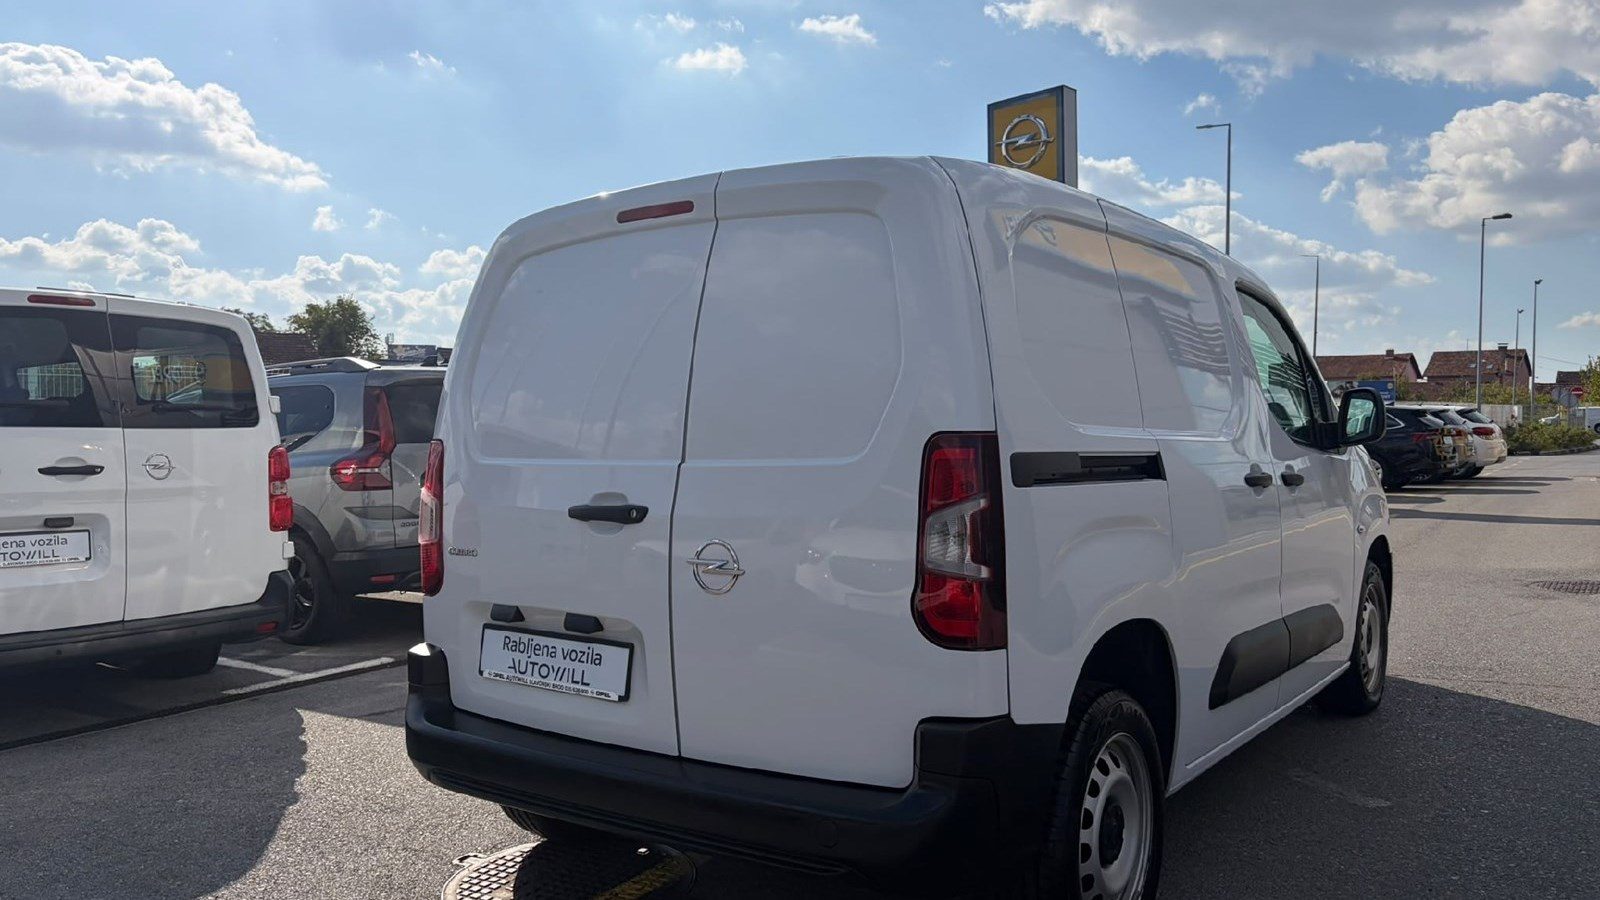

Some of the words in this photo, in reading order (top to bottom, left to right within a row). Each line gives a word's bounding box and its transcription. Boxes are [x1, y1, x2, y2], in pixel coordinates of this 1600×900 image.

[30, 535, 68, 547] vozila
[503, 636, 557, 659] Rabljena
[561, 646, 602, 667] vozila
[508, 658, 590, 686] AUTOWILL
